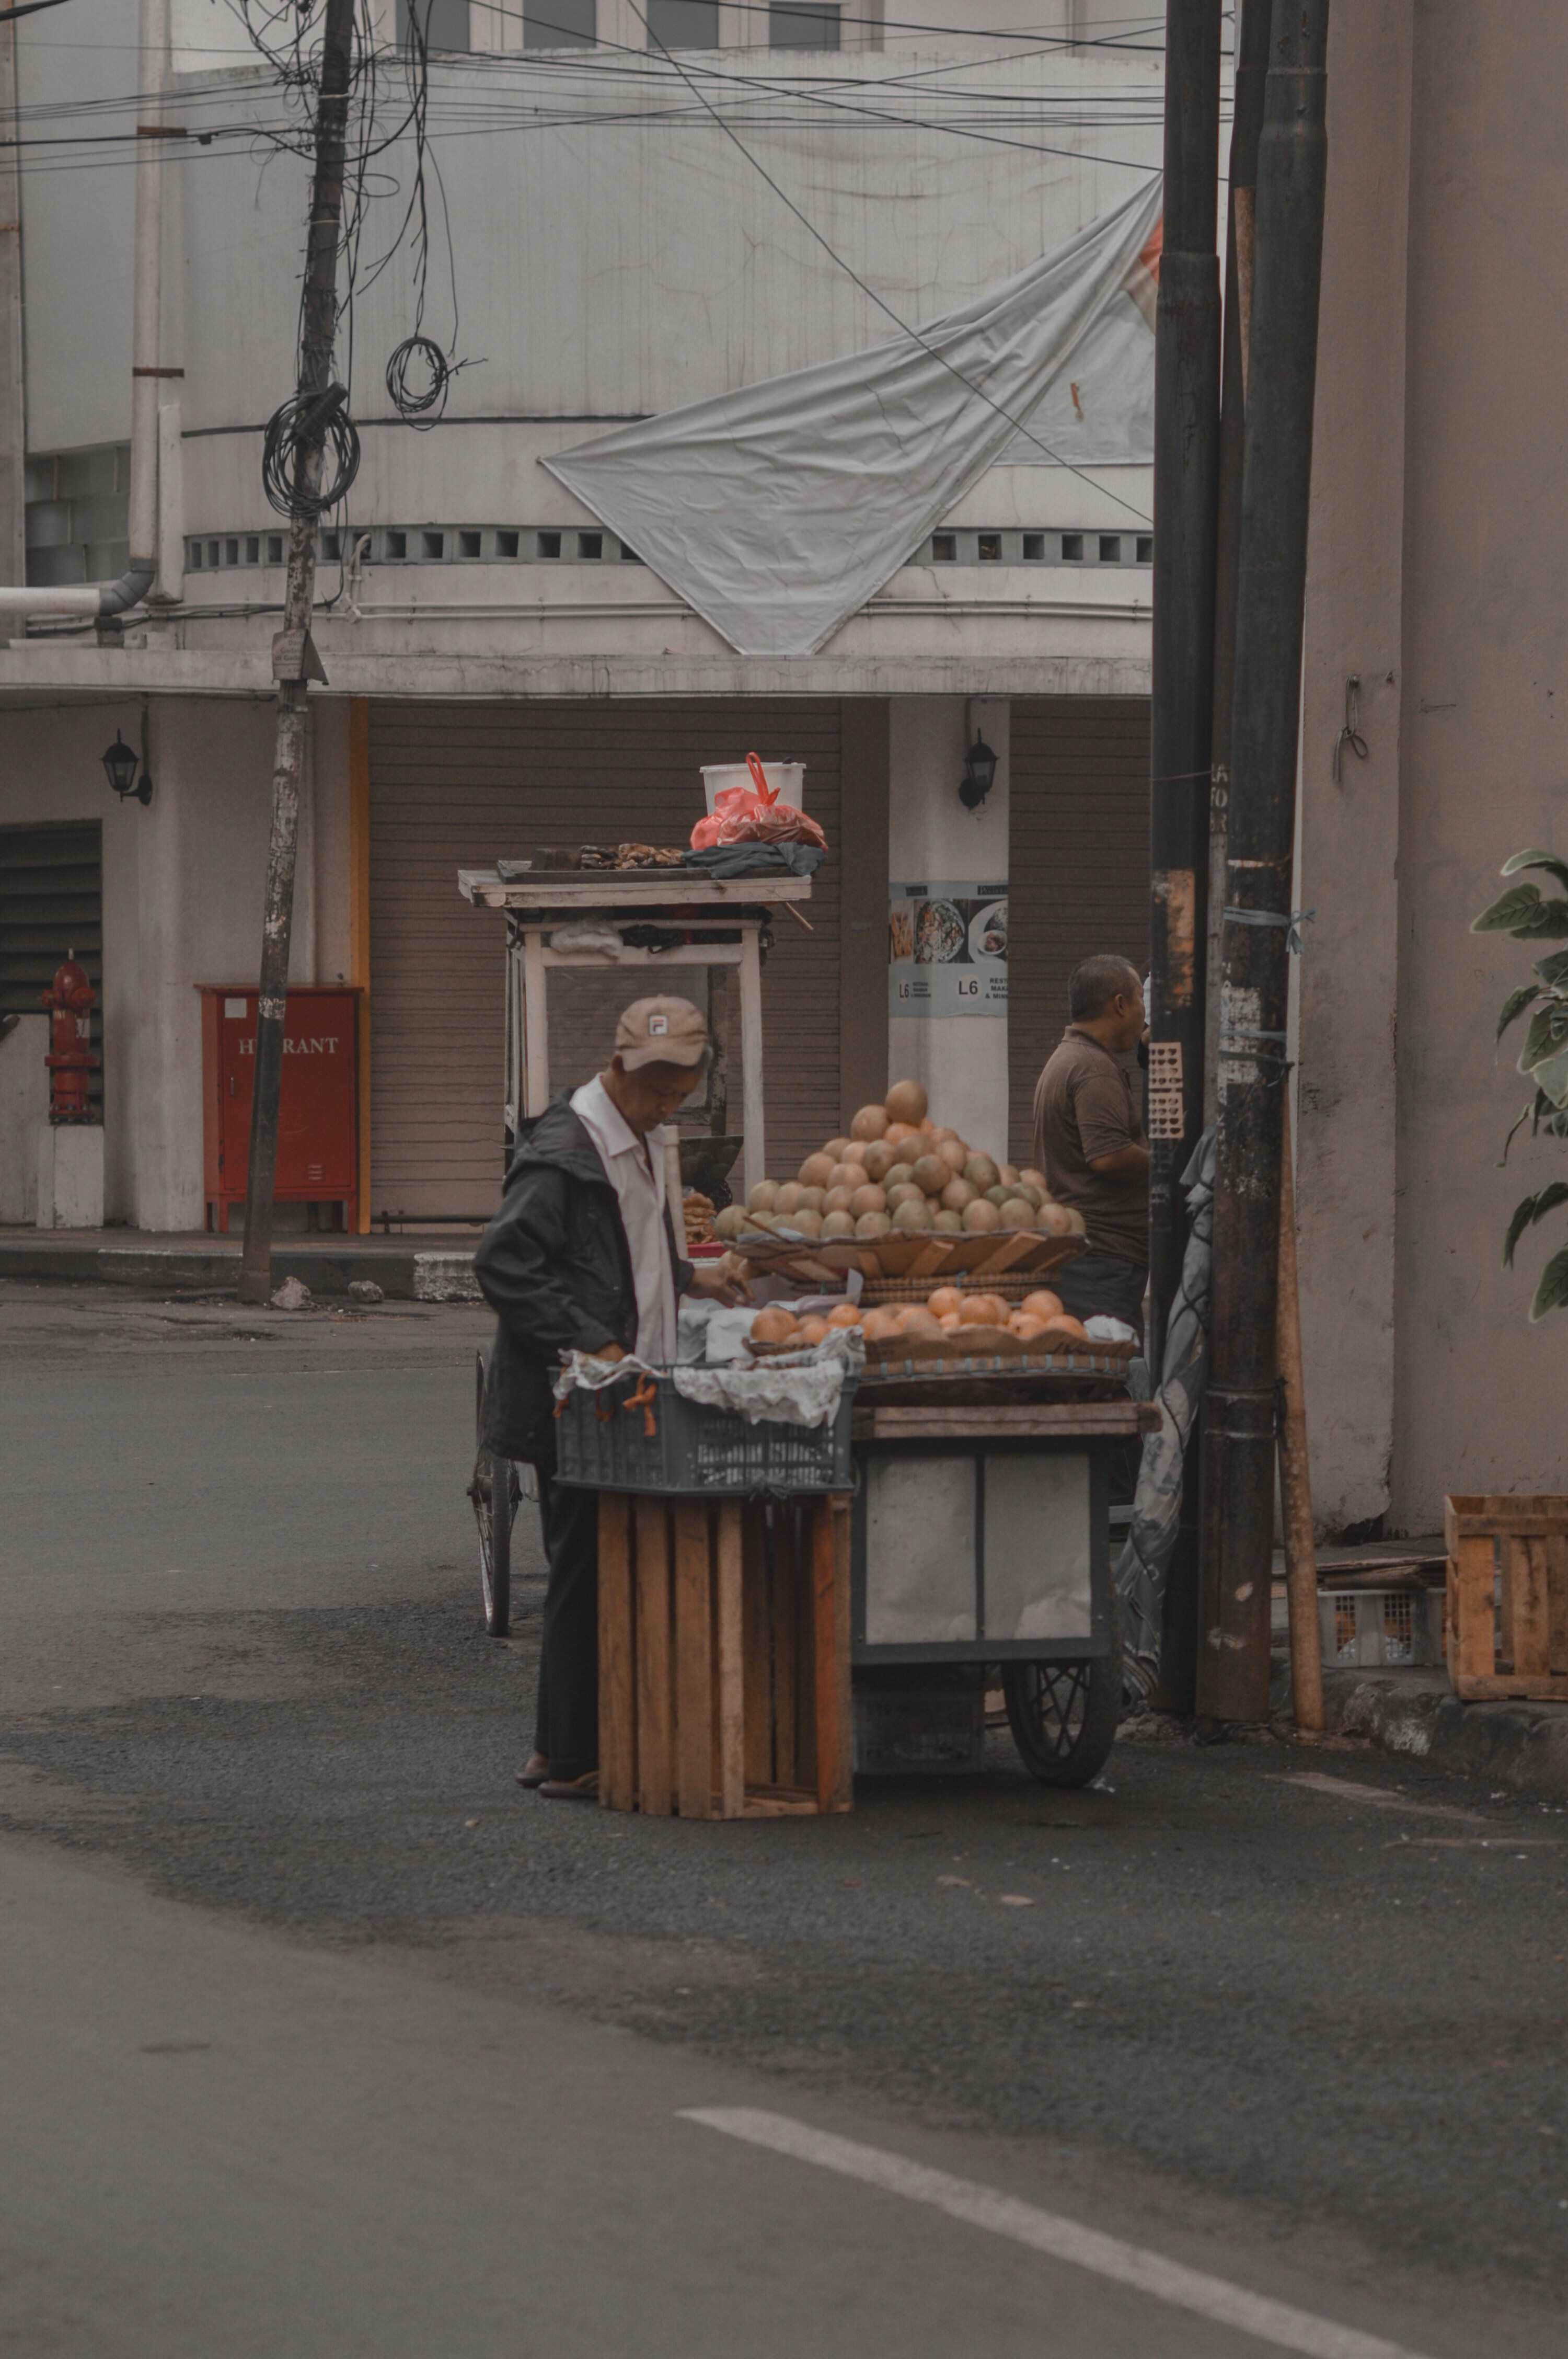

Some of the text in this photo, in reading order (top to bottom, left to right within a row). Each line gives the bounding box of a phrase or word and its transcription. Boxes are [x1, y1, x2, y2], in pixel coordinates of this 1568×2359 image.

[900, 983, 909, 998] L6
[959, 981, 978, 995] L6
[239, 1037, 339, 1054] HRANT
